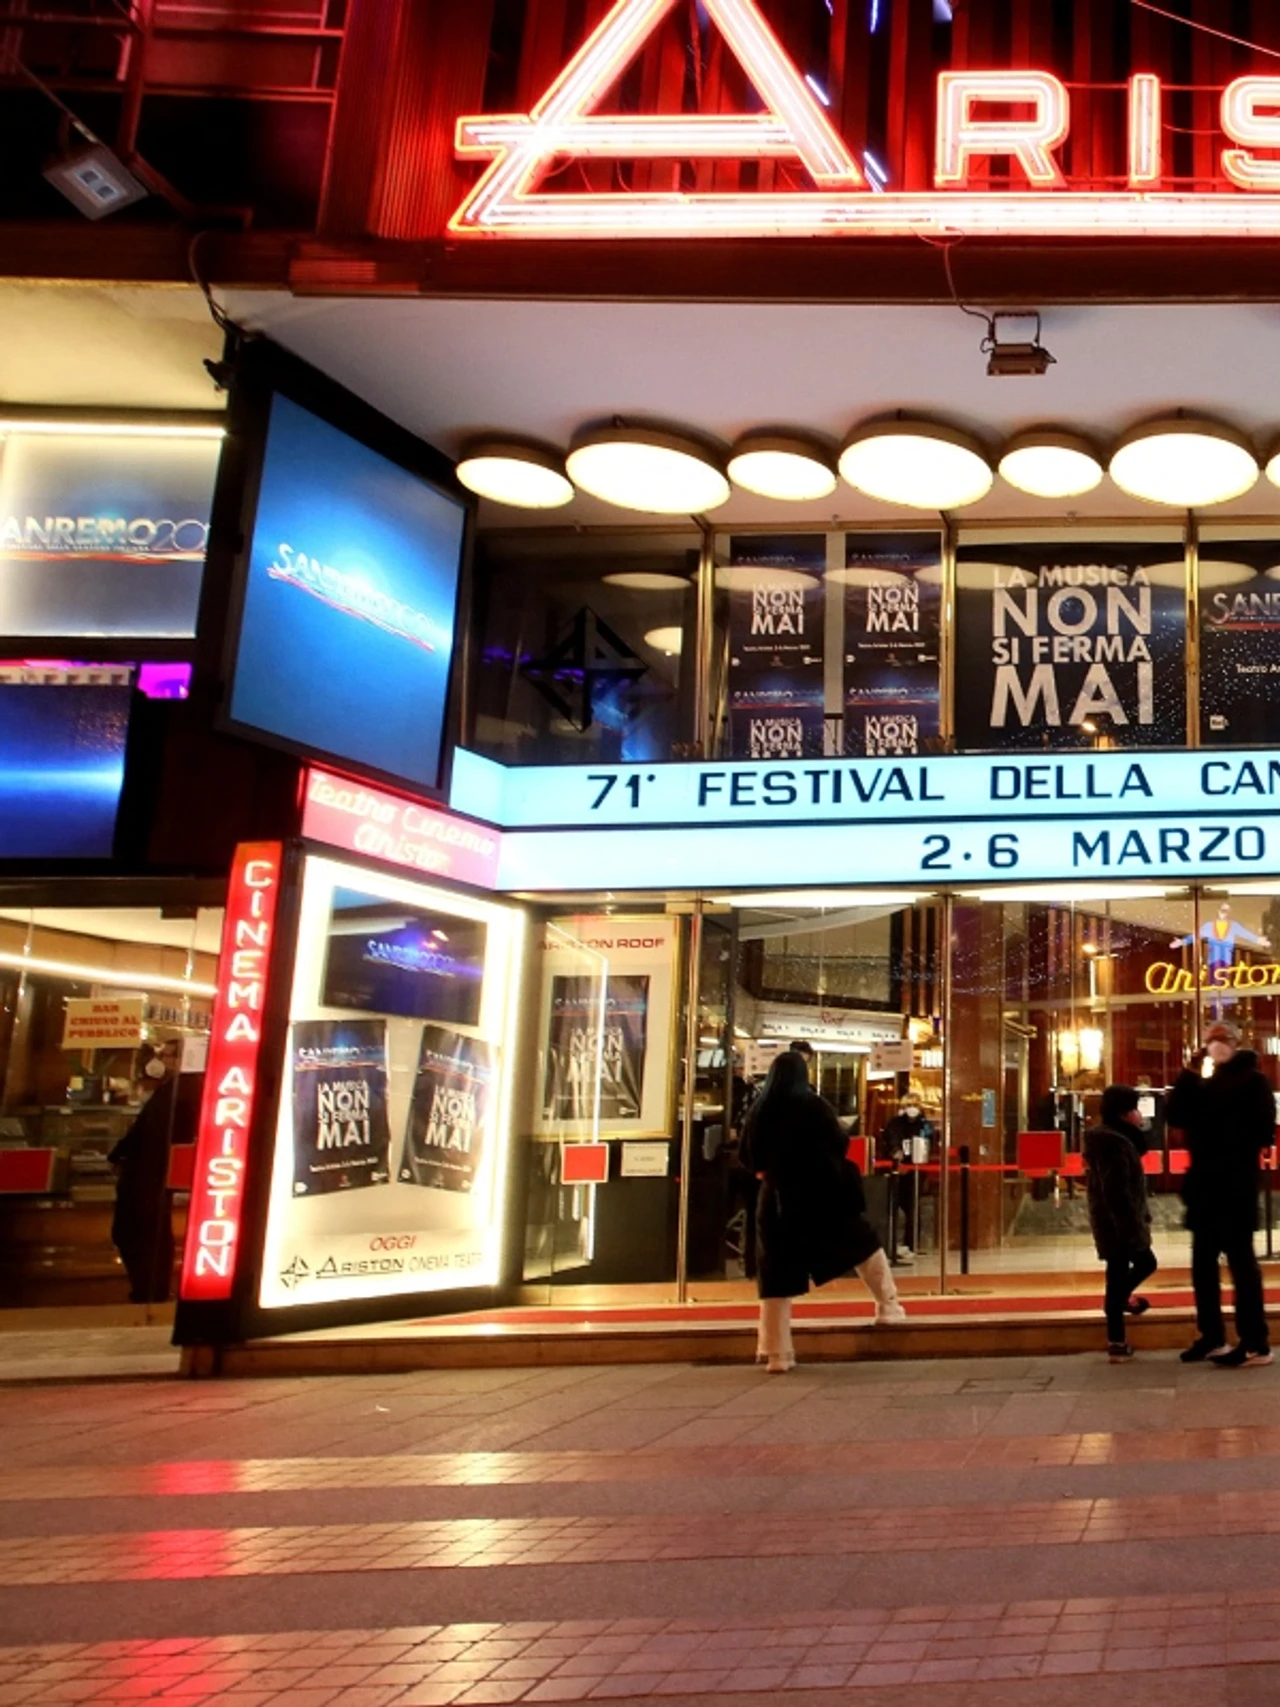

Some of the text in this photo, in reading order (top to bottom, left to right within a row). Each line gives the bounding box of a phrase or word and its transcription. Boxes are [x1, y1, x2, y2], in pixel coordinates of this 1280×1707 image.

[993, 565, 1150, 588] LA MUSICA
[753, 589, 804, 605] NON
[868, 588, 919, 603] NON
[866, 611, 919, 632] MAI
[992, 586, 1152, 637] NON
[751, 613, 804, 635] MAI
[991, 635, 1153, 664] SI FERMA
[989, 660, 1154, 727] MAI
[751, 725, 803, 743] NON
[866, 722, 918, 740] NON
[698, 765, 945, 808] FESTIVAL
[990, 763, 1153, 800] DELLA
[1073, 826, 1266, 867] MARZO
[225, 861, 274, 1043] CINEMA
[617, 938, 665, 949] ROOF
[318, 1090, 370, 1112] NON
[432, 1094, 476, 1121] NON
[317, 1120, 370, 1151] MAI
[424, 1123, 472, 1153] MAI
[195, 1066, 250, 1277] ARISTON
[369, 1235, 417, 1251] OGGI
[316, 1256, 405, 1278] ARISTON
[409, 1256, 449, 1273] CINEMA
